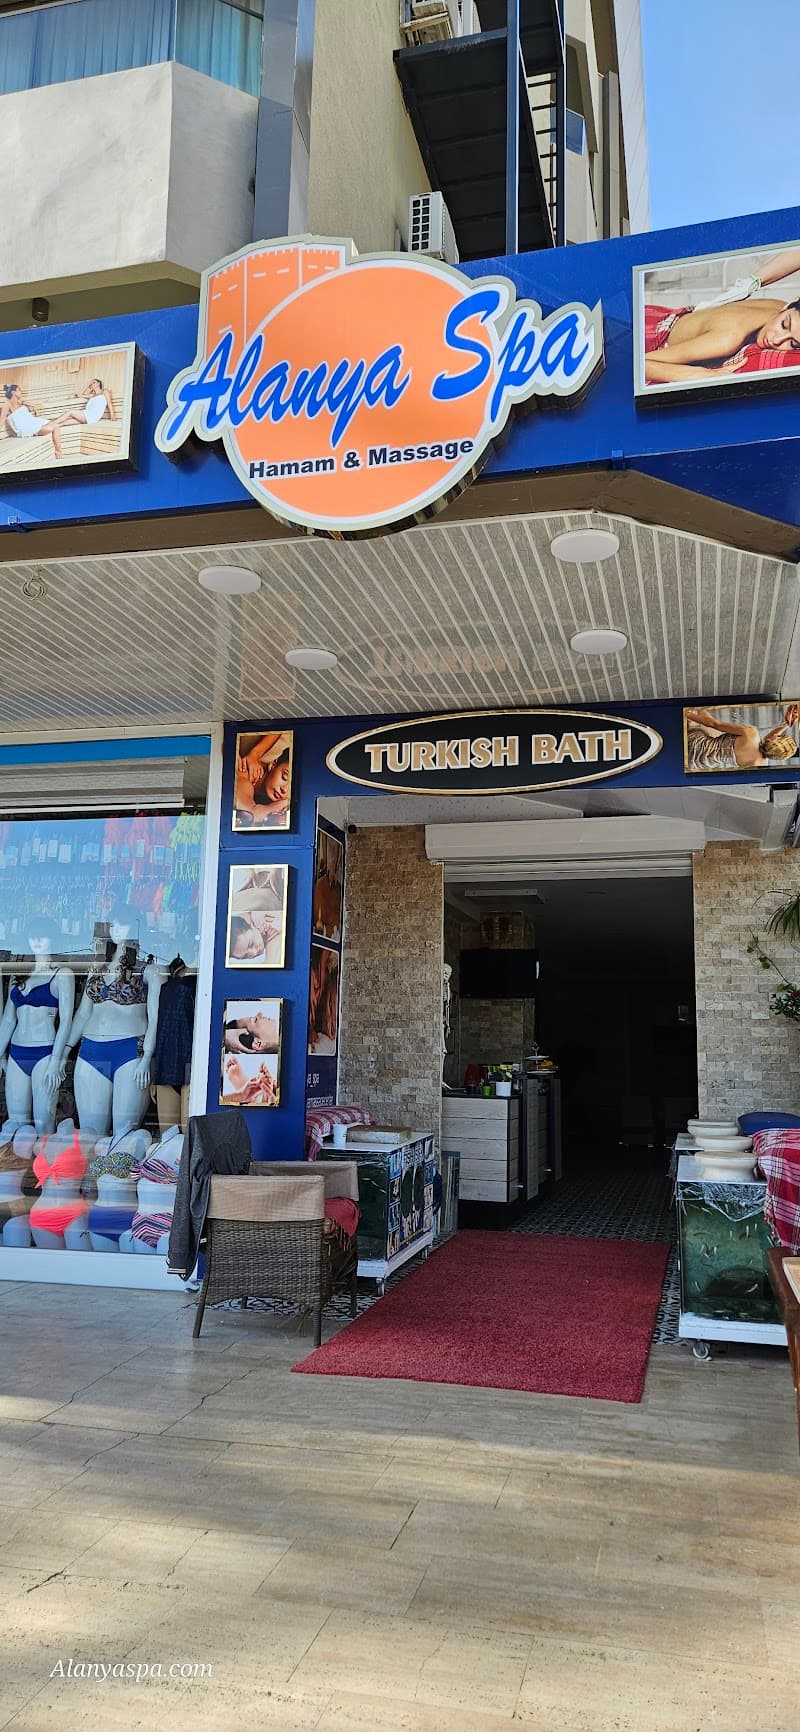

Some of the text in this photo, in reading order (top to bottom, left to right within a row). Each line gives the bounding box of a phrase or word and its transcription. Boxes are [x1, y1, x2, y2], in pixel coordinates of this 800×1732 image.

[166, 290, 589, 447] Alanya Spa
[249, 437, 474, 479] Hamam & Massage
[365, 728, 632, 774] TURKISH BATH
